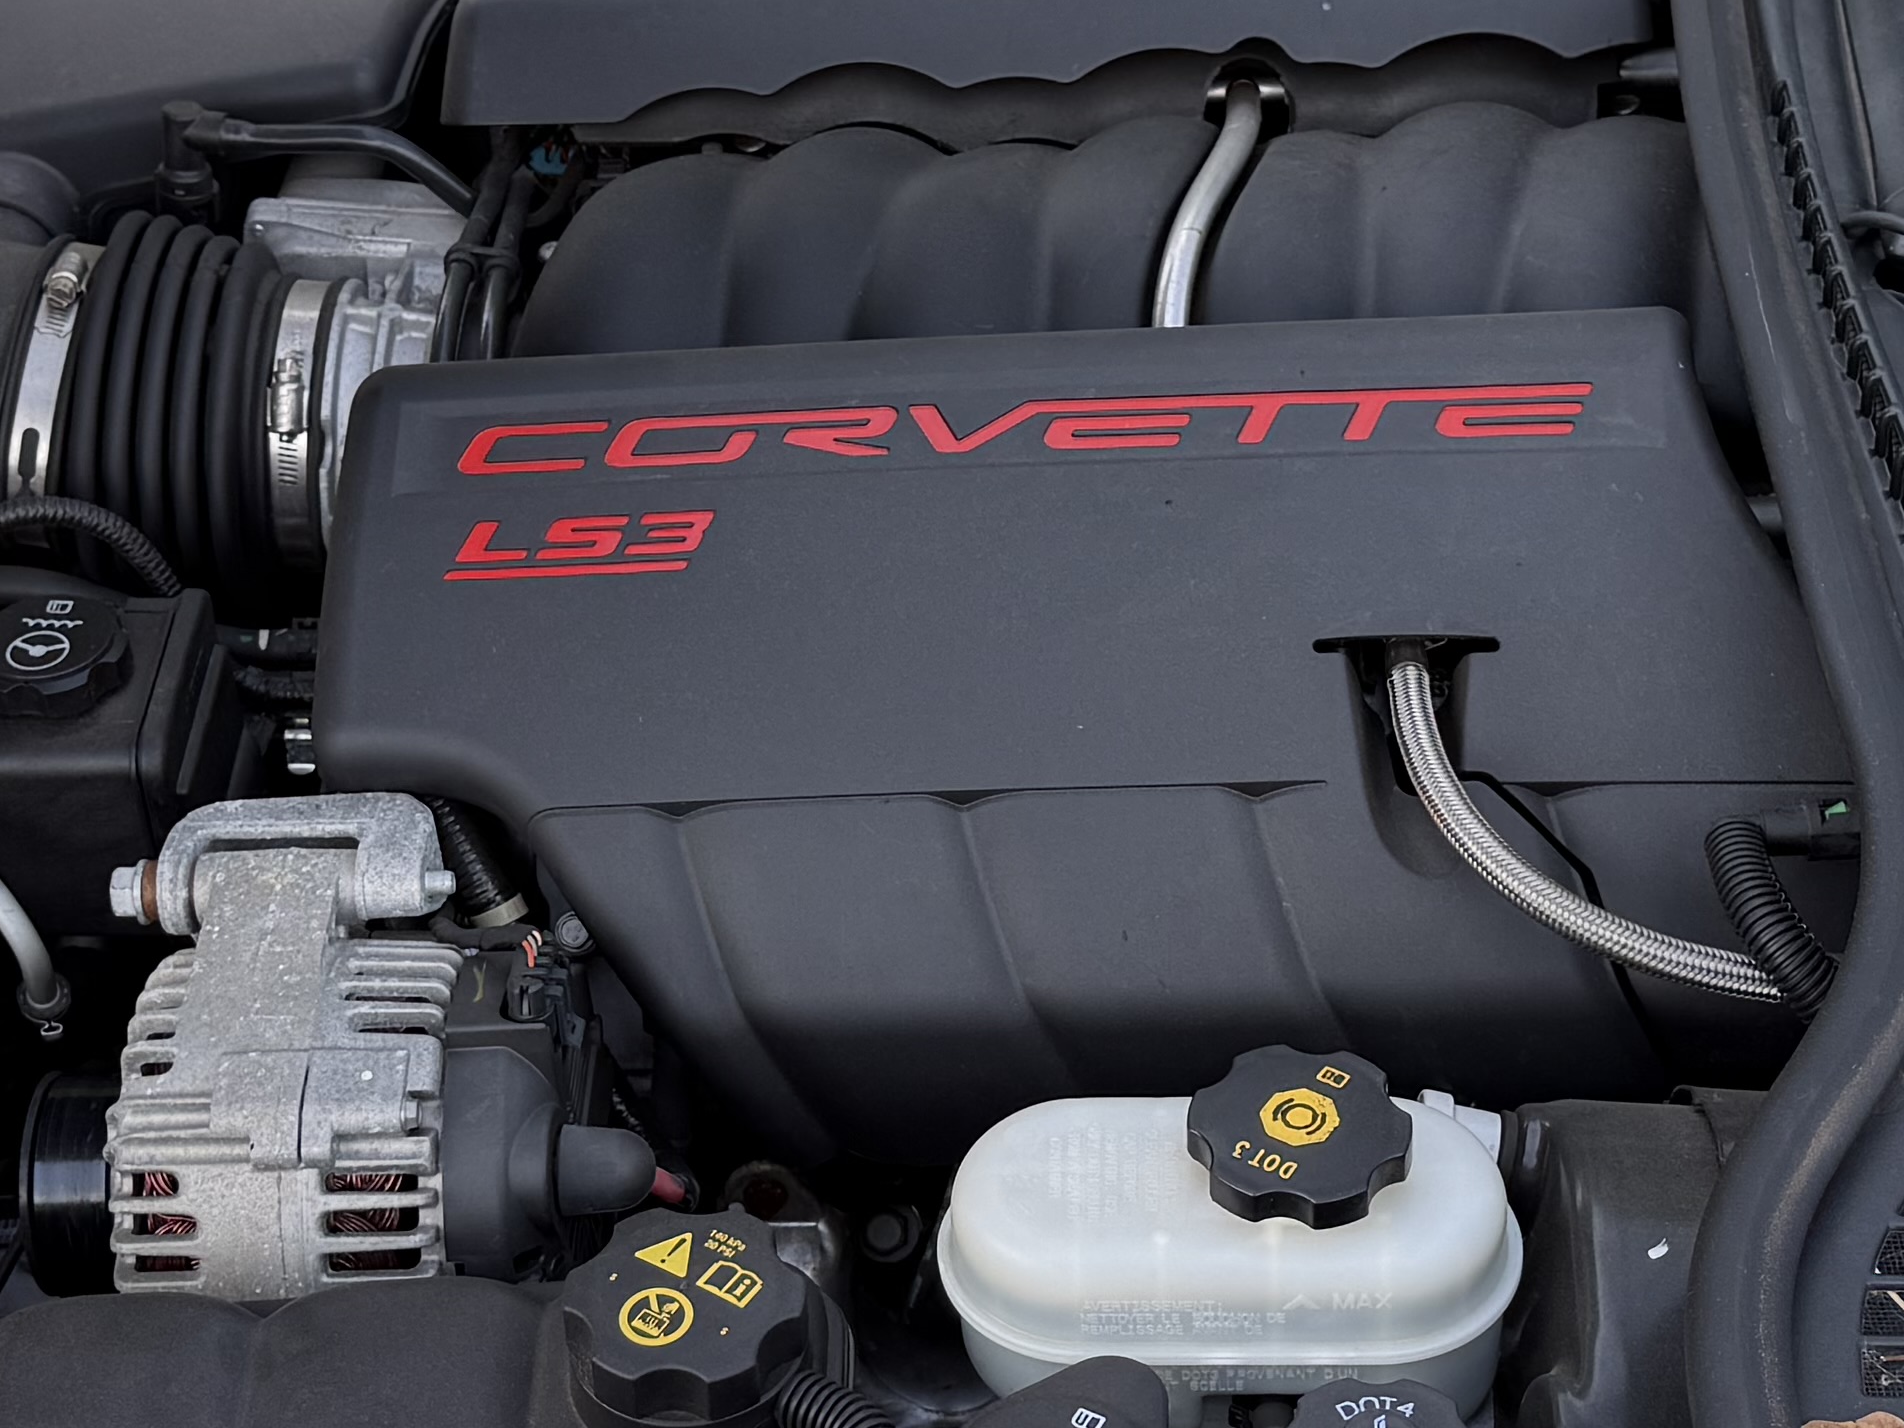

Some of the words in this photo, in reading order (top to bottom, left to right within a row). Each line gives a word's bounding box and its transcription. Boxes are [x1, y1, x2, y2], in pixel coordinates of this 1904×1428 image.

[459, 380, 1593, 475] CORVETTE
[453, 508, 715, 564] LS3
[1231, 1139, 1252, 1160] 3
[1247, 1147, 1300, 1181] DOT
[717, 1245, 736, 1258] PSI
[1331, 1291, 1394, 1311] MAX
[1080, 1312, 1155, 1325] NETTOYER
[1160, 1312, 1181, 1325] LE
[1267, 1312, 1287, 1325] DE
[1080, 1323, 1185, 1336] REMPLISSAGE
[1245, 1324, 1265, 1336] DE
